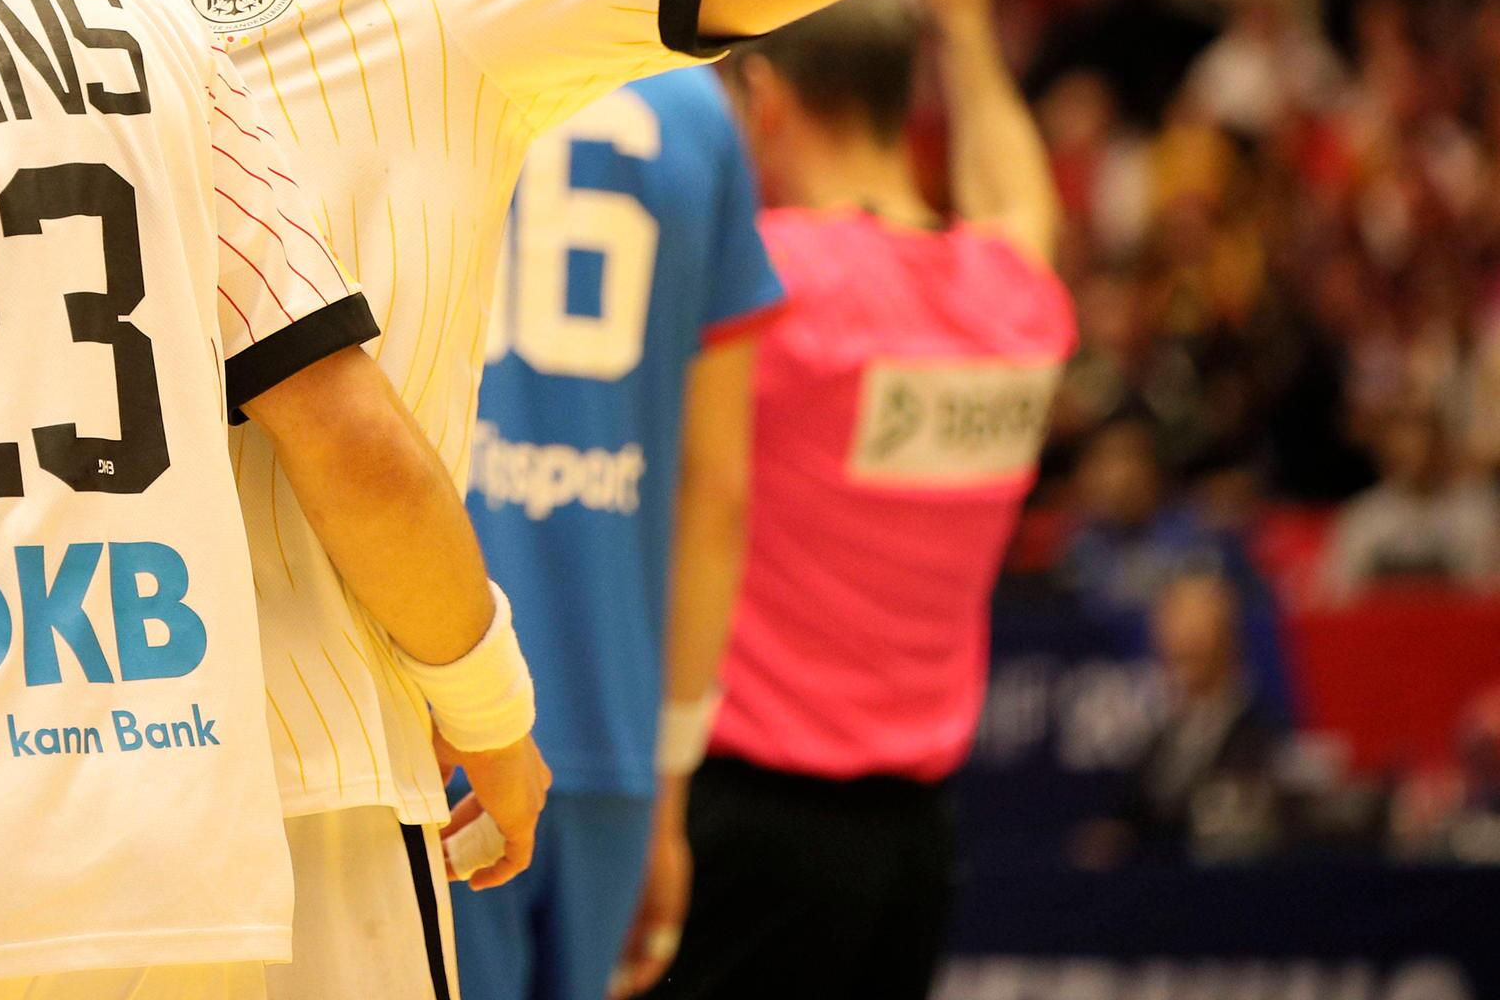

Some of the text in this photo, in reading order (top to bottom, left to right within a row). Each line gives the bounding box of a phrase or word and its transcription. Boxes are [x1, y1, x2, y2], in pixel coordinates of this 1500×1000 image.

[97, 458, 115, 475] DHB
[6, 713, 104, 757] kann
[111, 703, 221, 752] Bank
